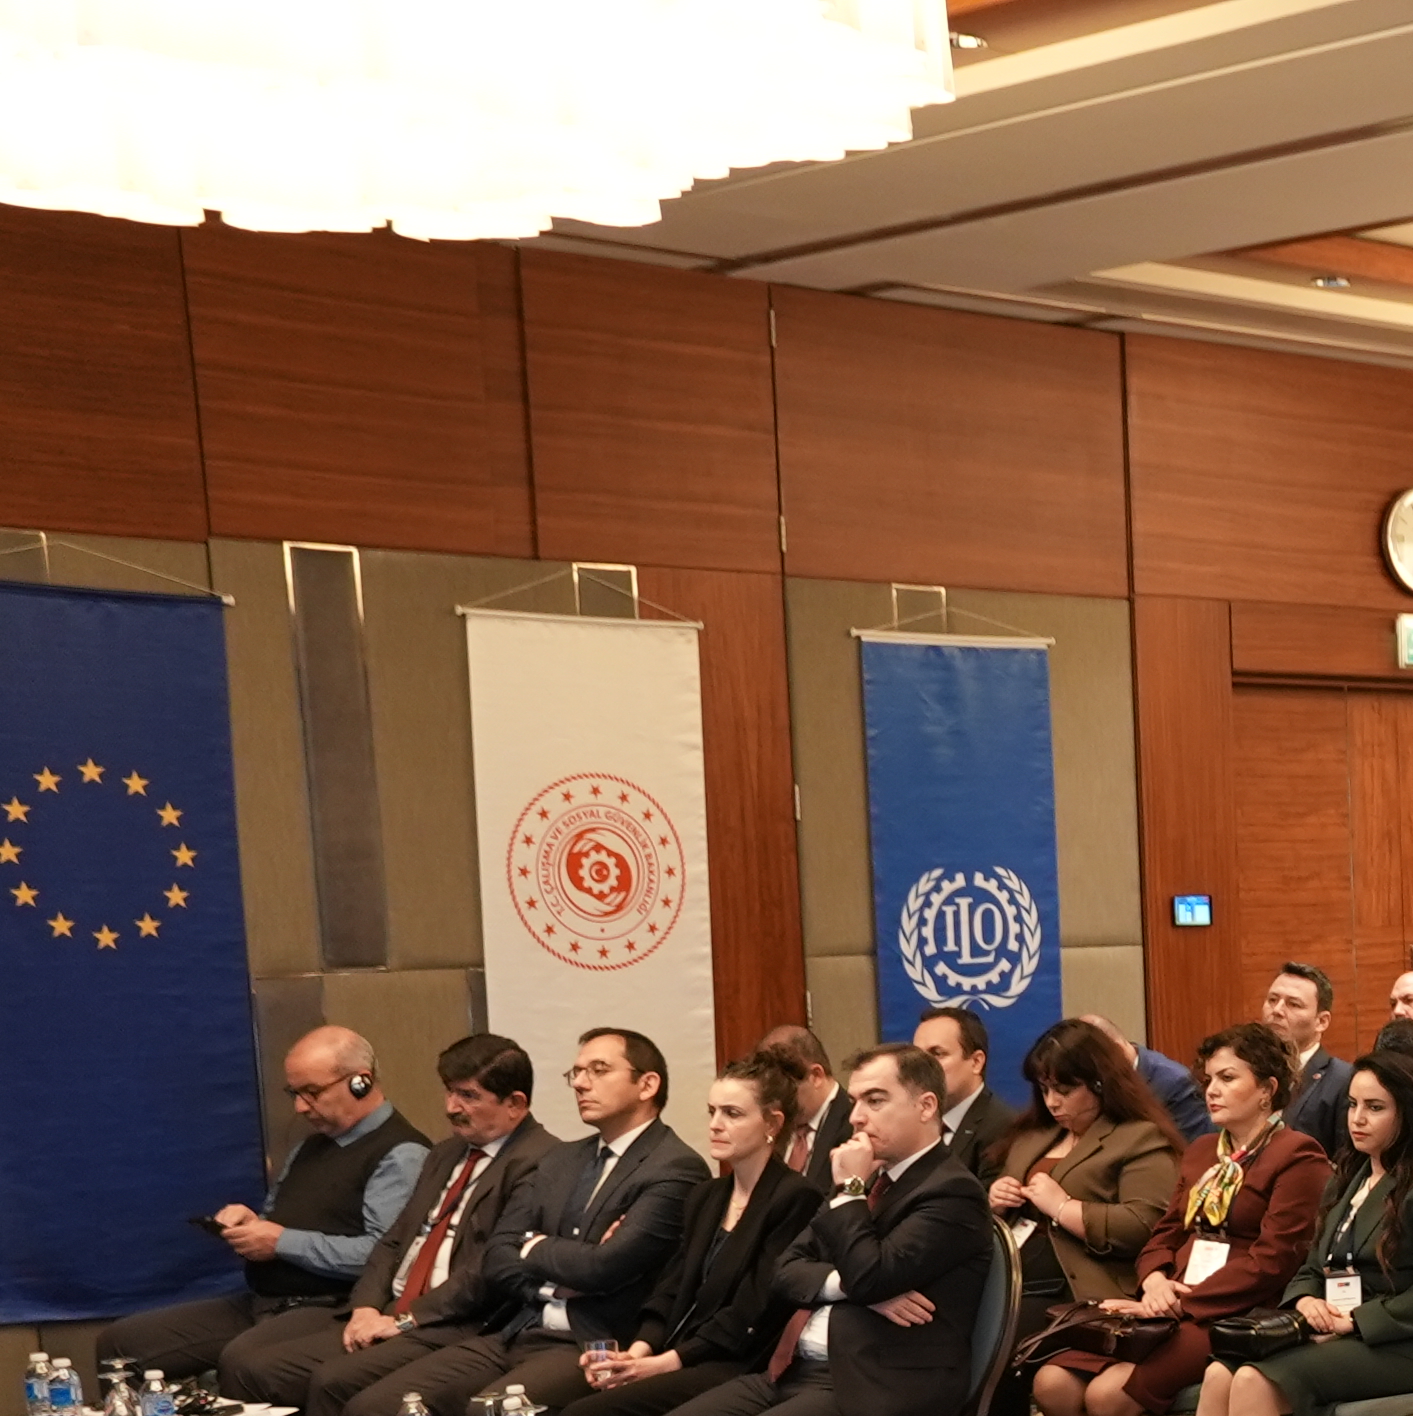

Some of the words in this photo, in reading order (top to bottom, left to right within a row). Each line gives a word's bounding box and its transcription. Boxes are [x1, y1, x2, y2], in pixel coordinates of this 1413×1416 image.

[550, 827, 564, 841] VE
[562, 809, 602, 828] SOSYAL
[941, 896, 1004, 965] ILO
